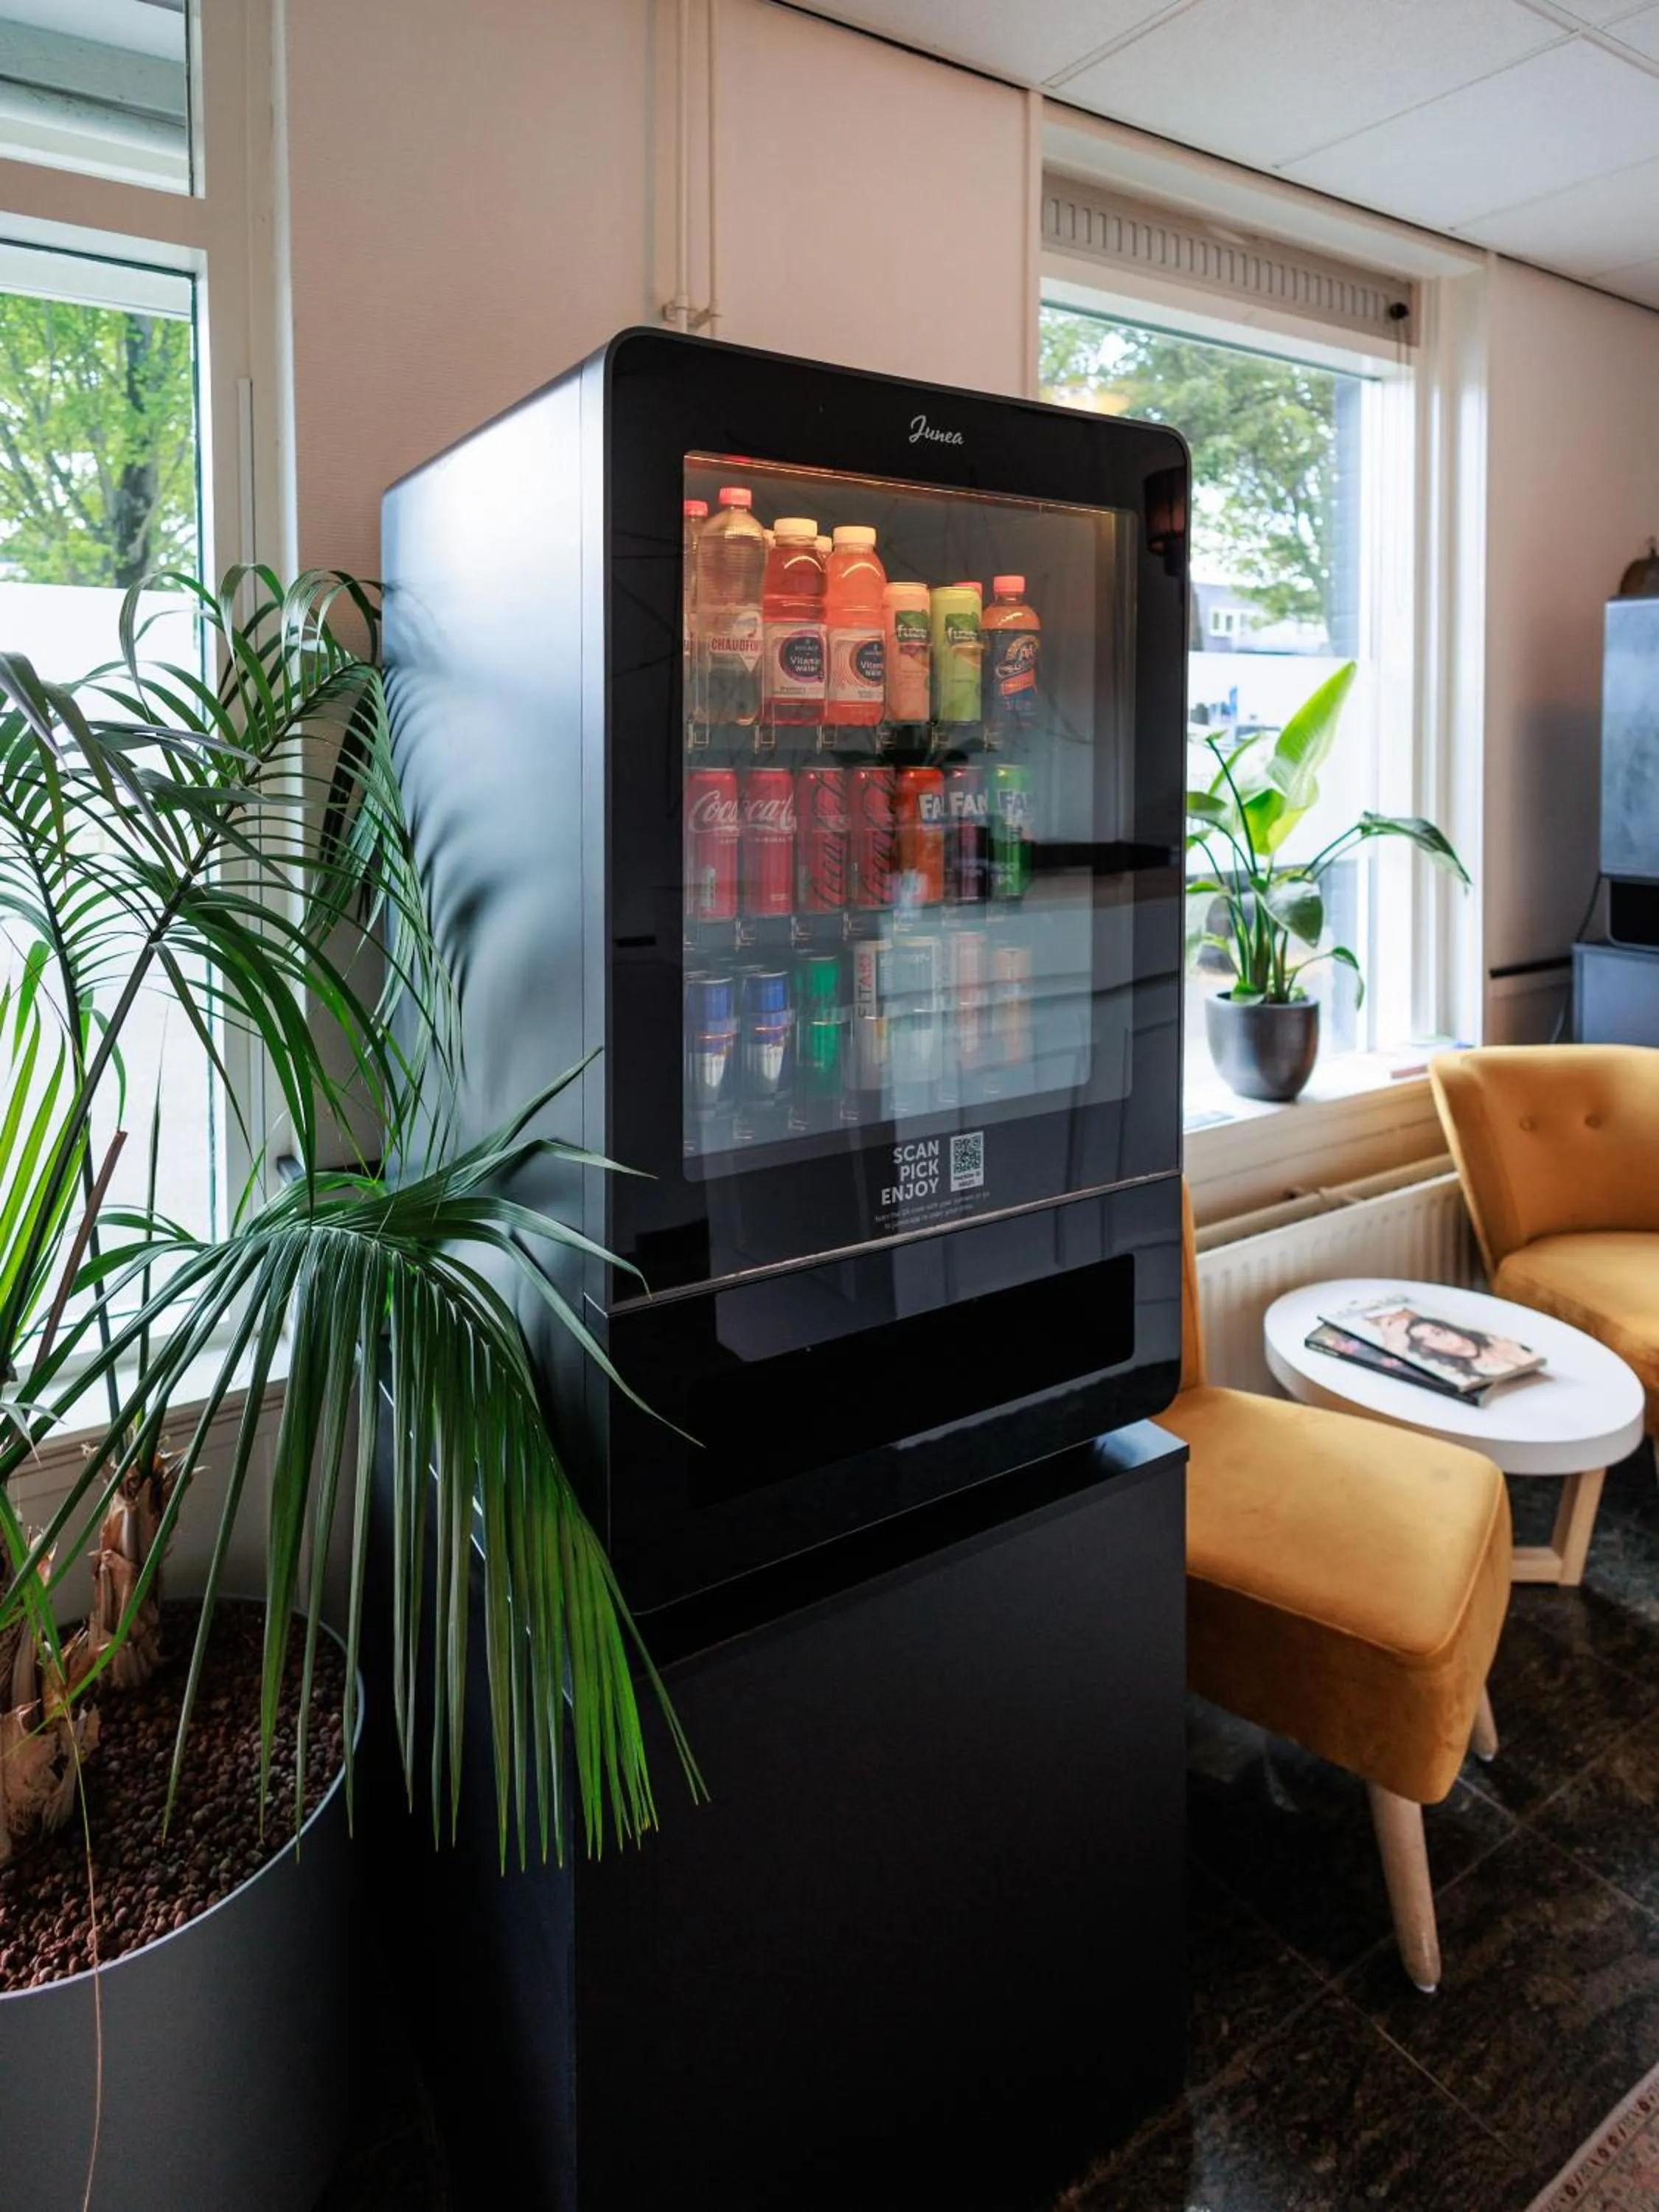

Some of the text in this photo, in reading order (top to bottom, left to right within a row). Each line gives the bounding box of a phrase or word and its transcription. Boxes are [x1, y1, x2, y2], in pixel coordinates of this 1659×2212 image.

[893, 1140, 939, 1164] SCAN
[900, 1158, 939, 1182] PICK
[881, 1178, 939, 1206] ENJOY
